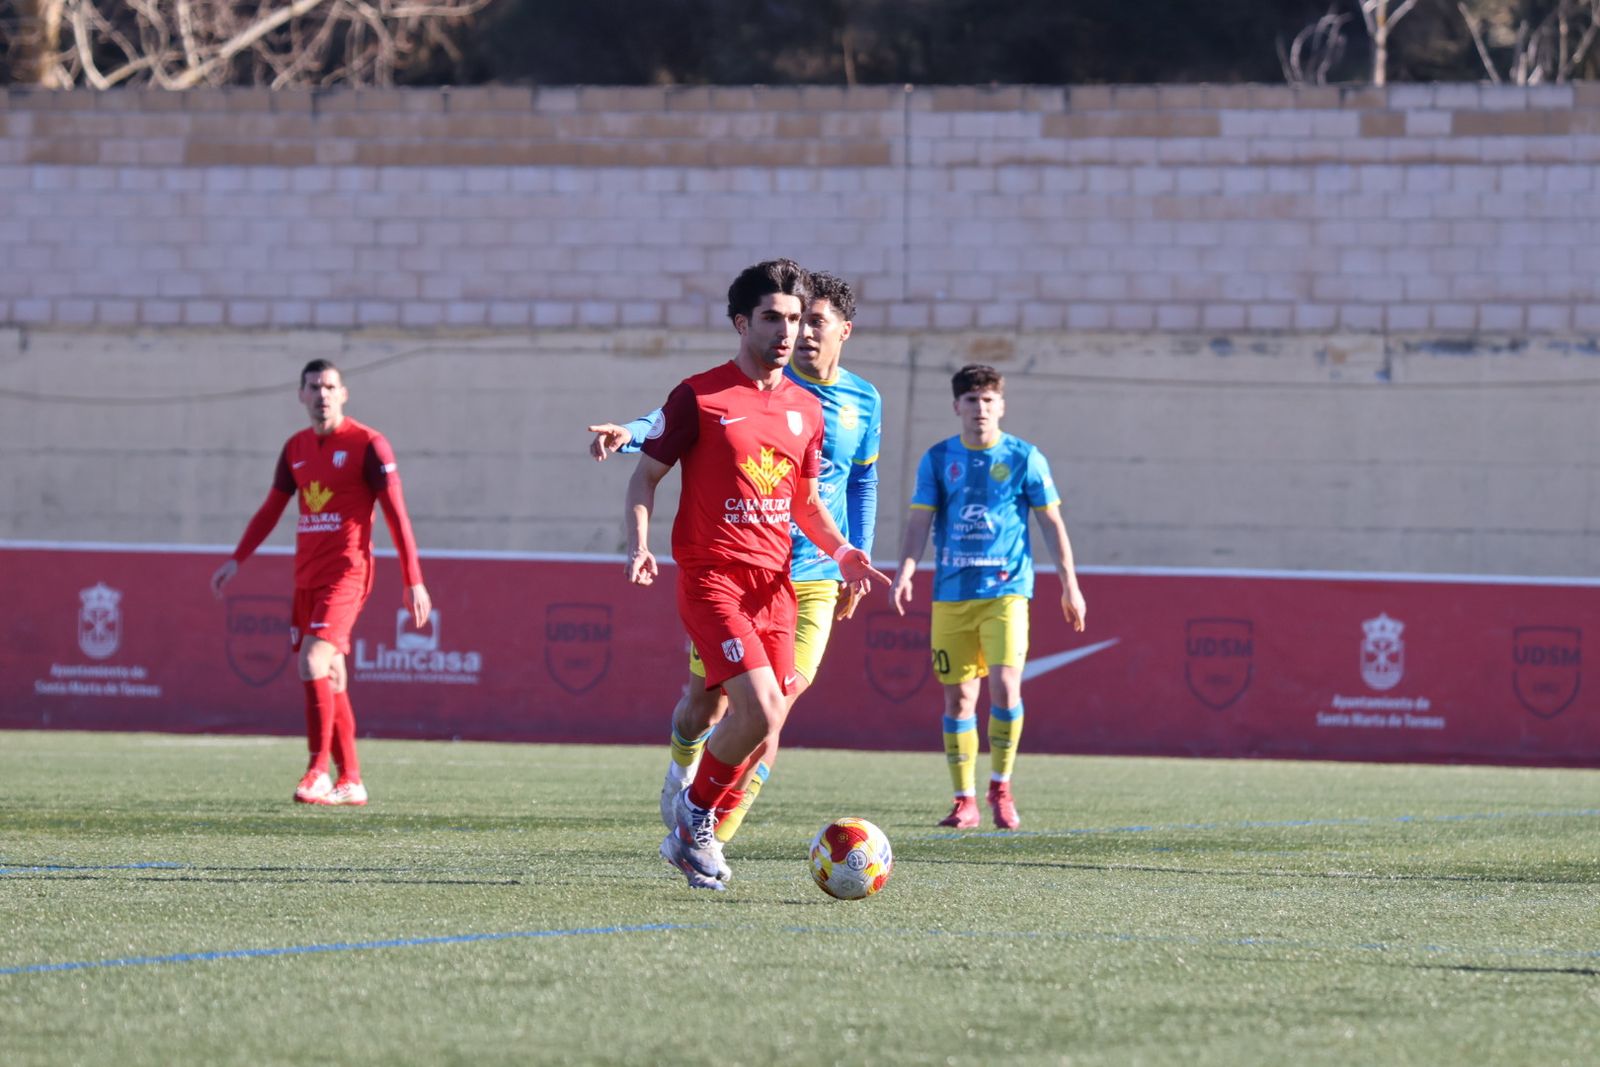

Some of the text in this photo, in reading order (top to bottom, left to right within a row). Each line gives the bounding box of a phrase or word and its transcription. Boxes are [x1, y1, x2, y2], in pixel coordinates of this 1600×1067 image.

[725, 514, 739, 523] DE
[546, 623, 613, 642] UDSM
[355, 639, 481, 672] Limcasa
[1186, 637, 1253, 657] UDSM
[1513, 645, 1581, 666] UDSM
